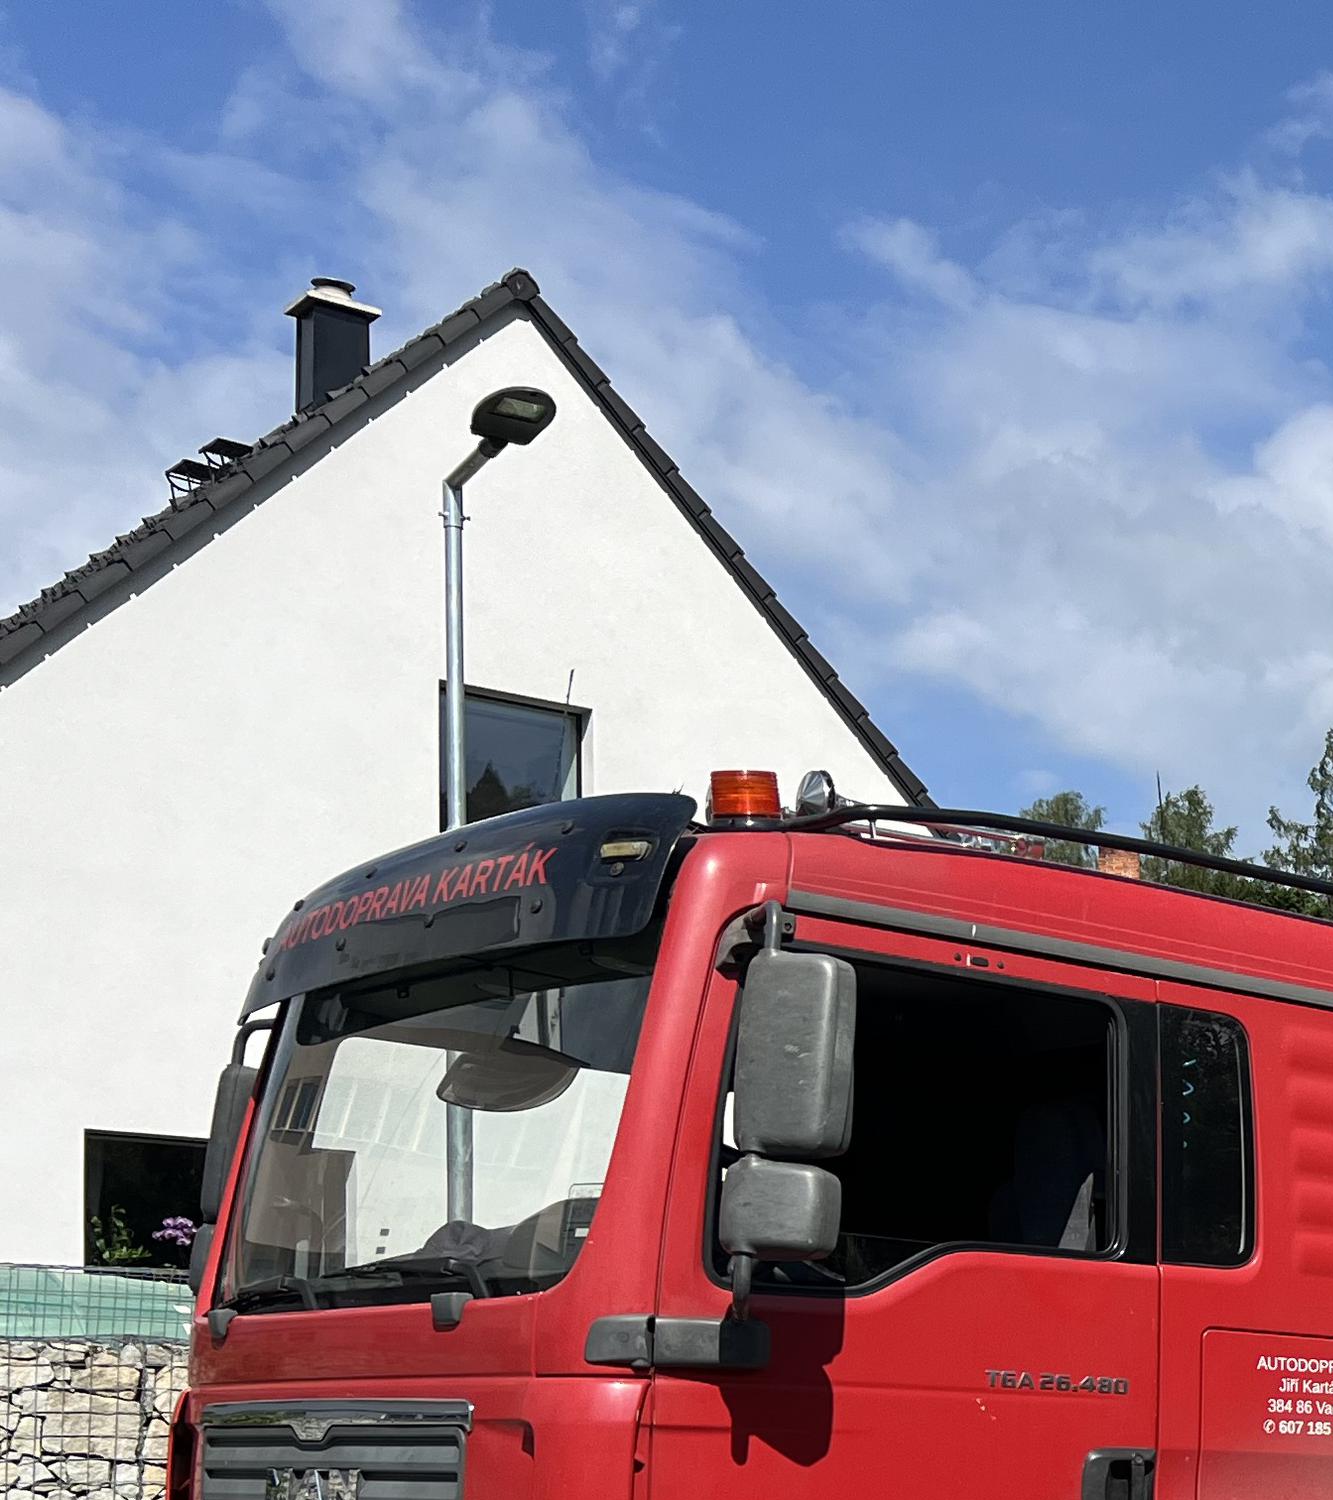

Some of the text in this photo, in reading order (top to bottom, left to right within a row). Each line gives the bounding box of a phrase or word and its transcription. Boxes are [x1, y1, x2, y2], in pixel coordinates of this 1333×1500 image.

[280, 842, 559, 951] AUTODOPRAVA KARTÁK
[985, 1369, 1130, 1395] TGA 26.480
[1278, 1377, 1300, 1393] Jiří
[1267, 1398, 1293, 1414] 384
[1295, 1399, 1313, 1414] 86
[1278, 1420, 1304, 1435] 607
[1306, 1421, 1332, 1436] 185
